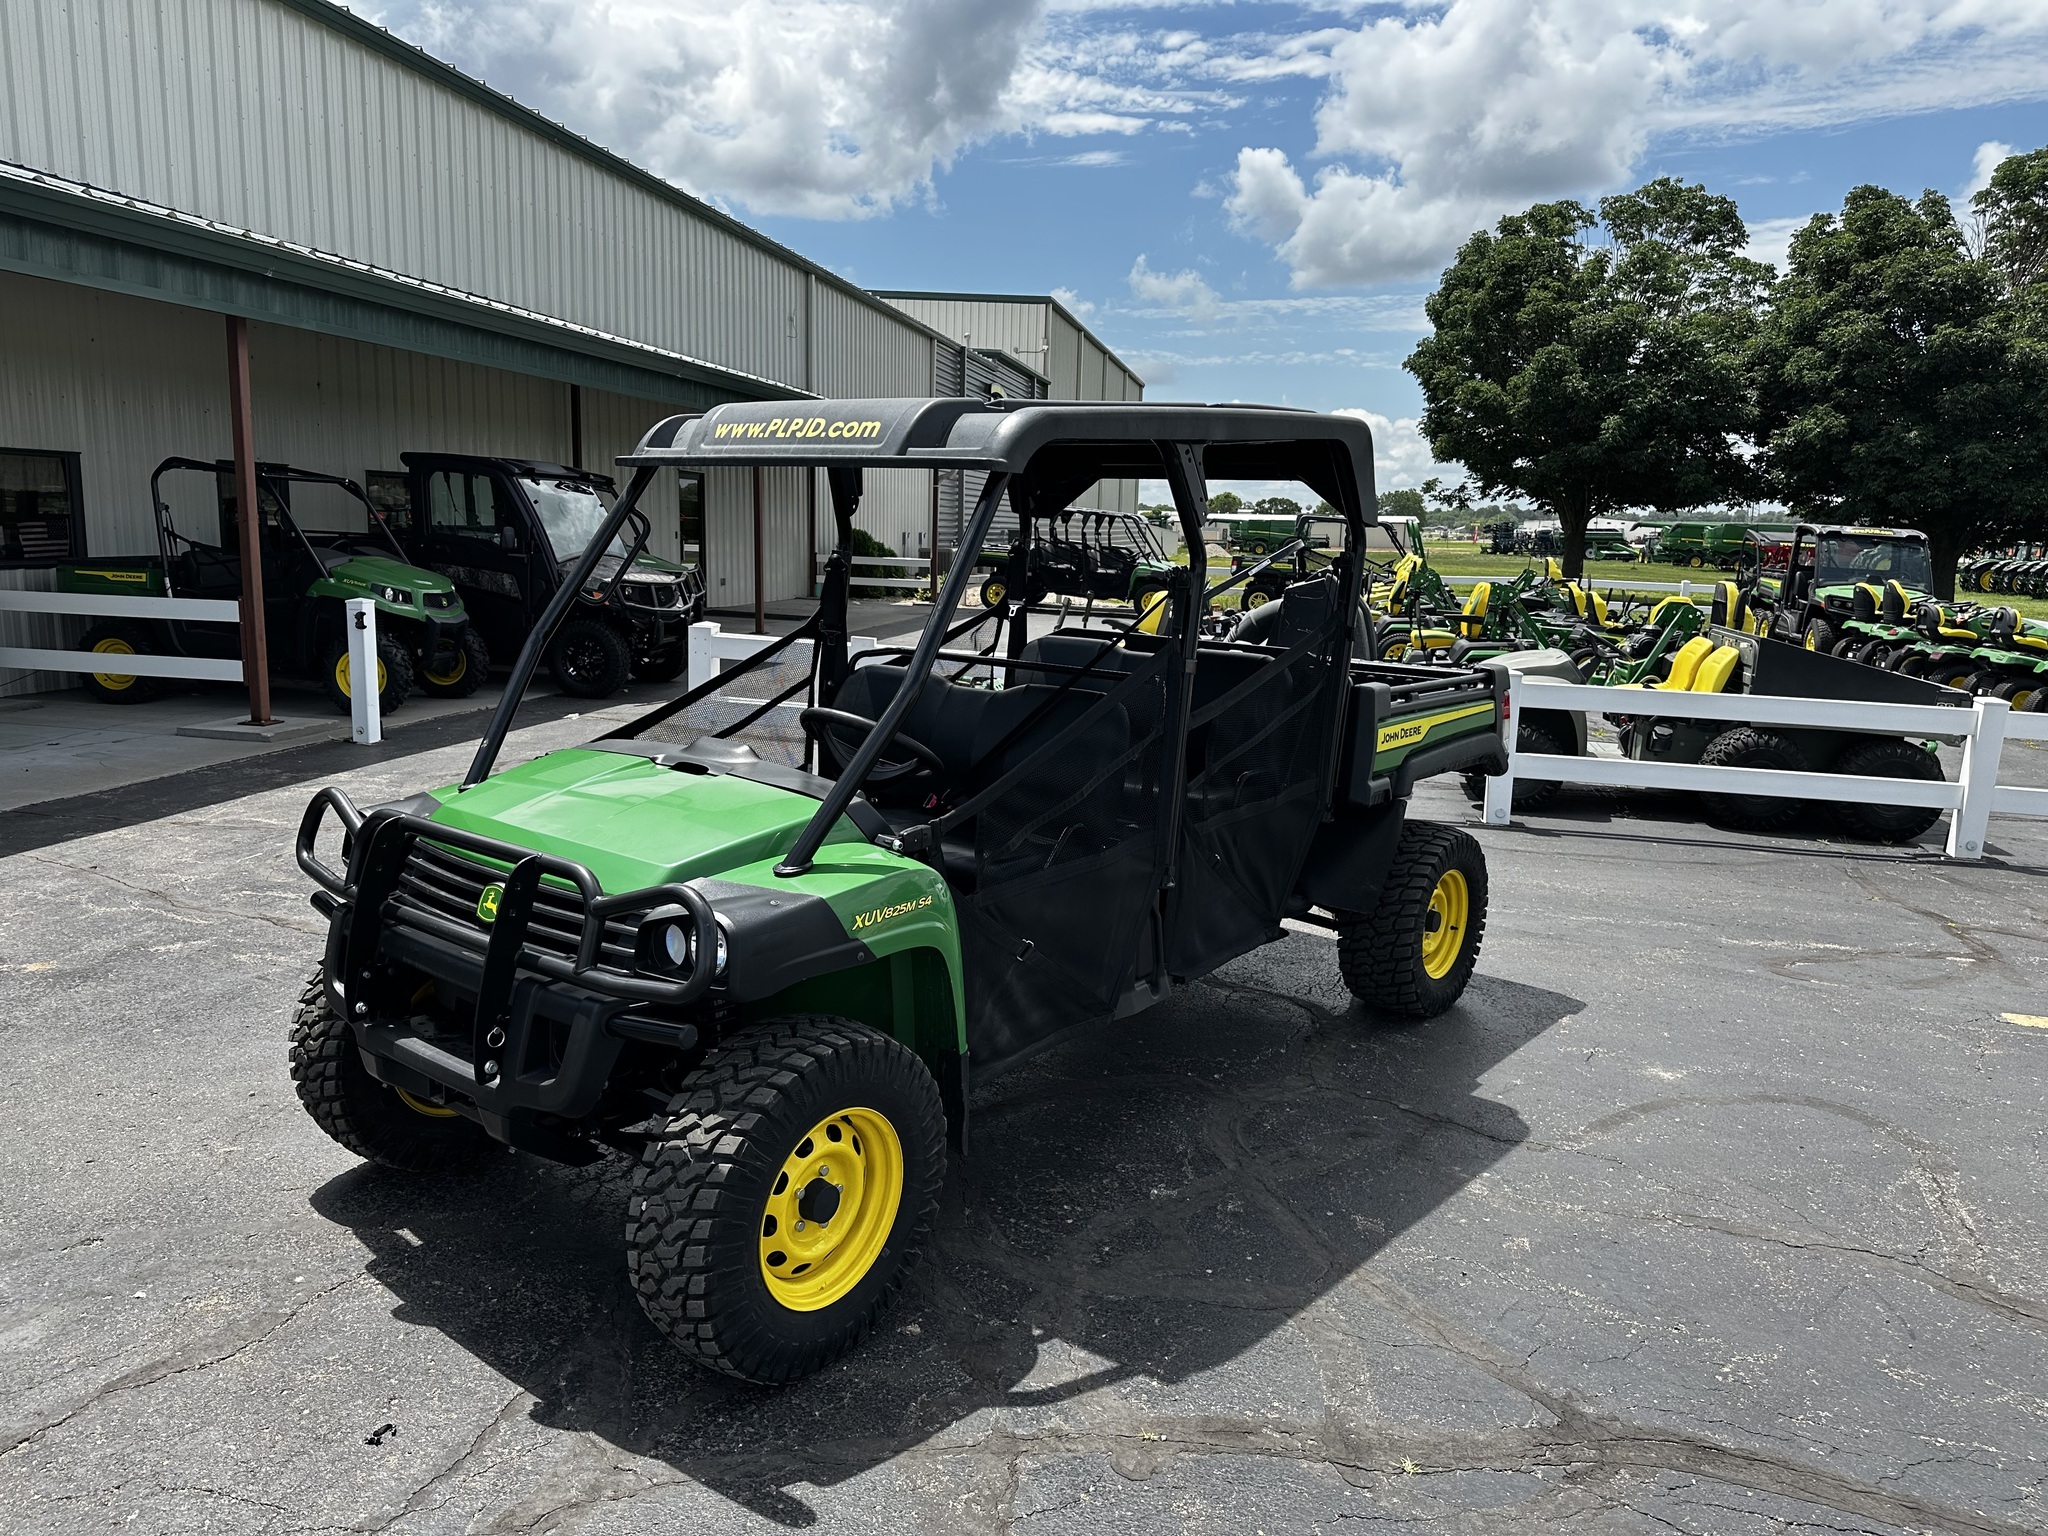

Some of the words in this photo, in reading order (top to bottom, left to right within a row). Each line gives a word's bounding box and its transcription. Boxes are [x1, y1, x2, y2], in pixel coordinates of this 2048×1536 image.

[714, 417, 882, 439] www.PLPJD.com
[1381, 732, 1399, 744] JOHN
[1400, 726, 1421, 739] DEERE
[852, 900, 916, 930] XUV825M
[918, 895, 932, 908] S4
